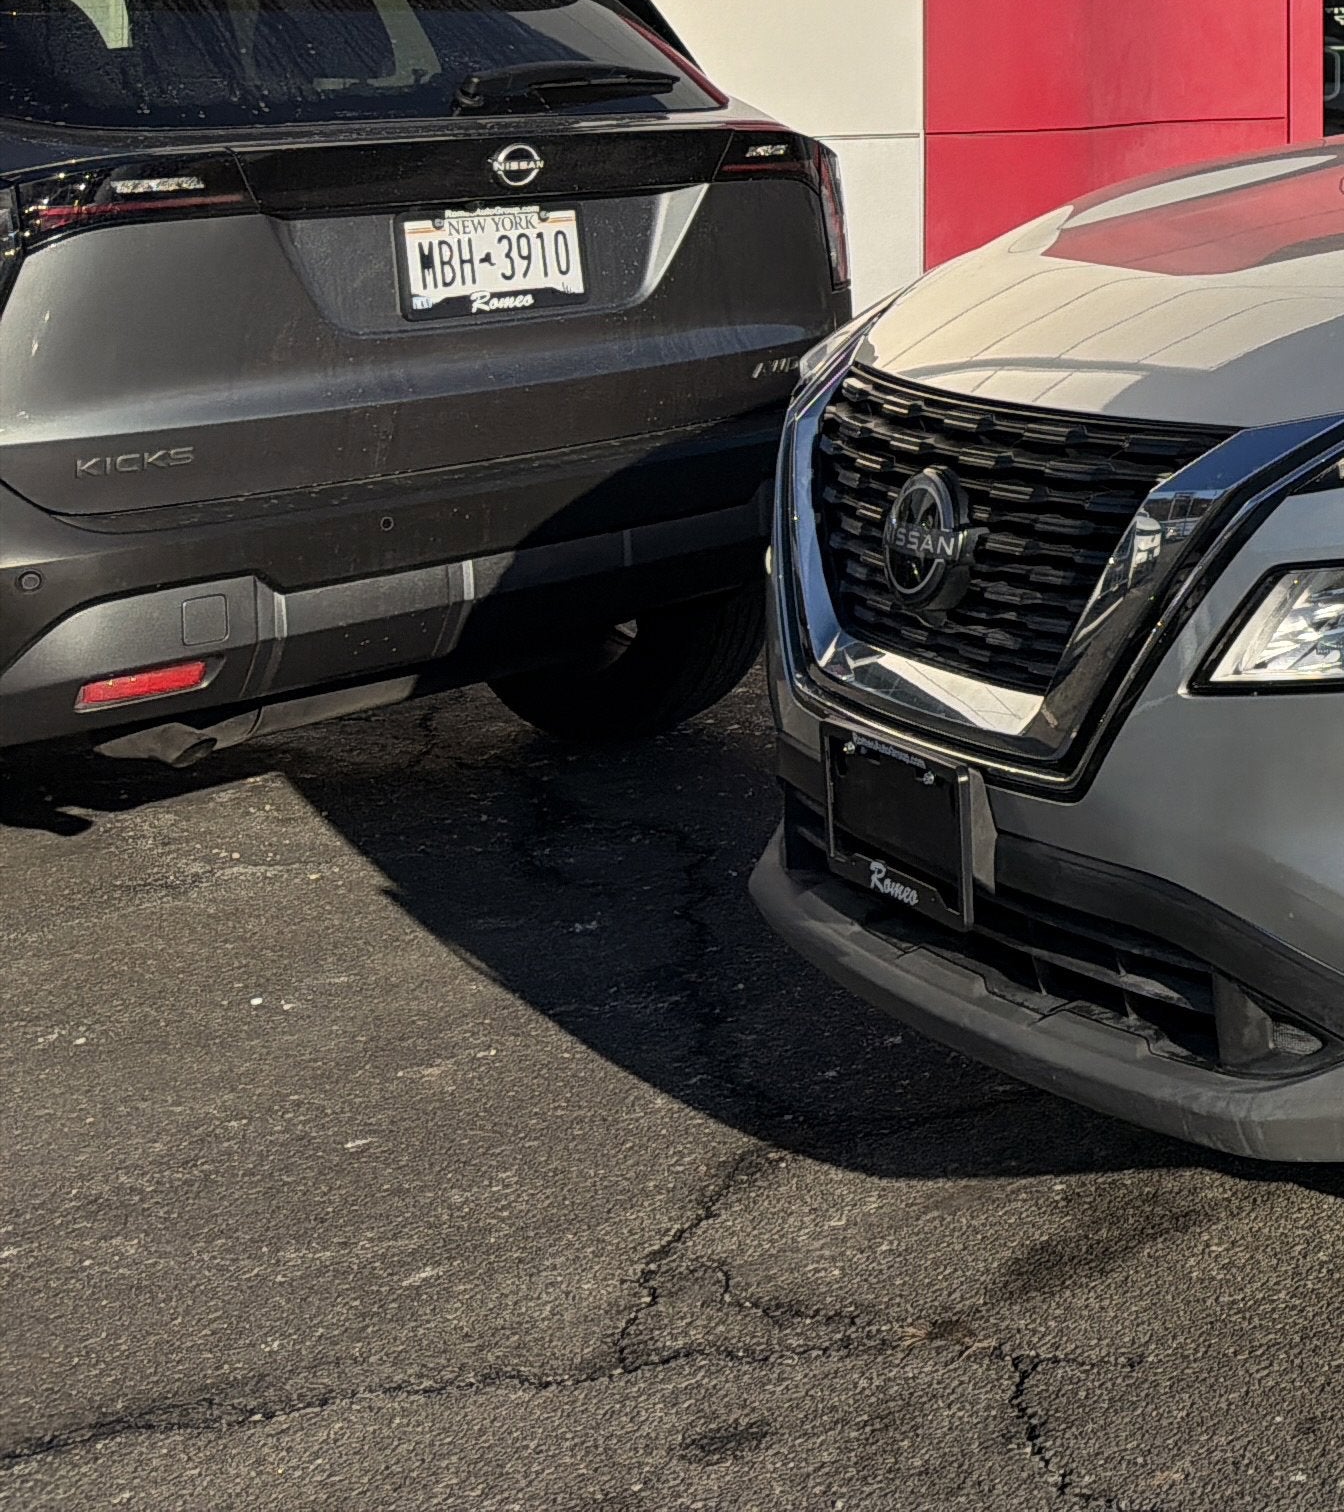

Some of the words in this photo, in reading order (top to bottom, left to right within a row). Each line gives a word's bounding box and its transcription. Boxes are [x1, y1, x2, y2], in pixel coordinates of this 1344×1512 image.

[493, 160, 544, 171] NISSAN
[447, 218, 487, 237] NEW
[490, 214, 538, 234] YORK
[417, 237, 477, 291] MBH
[497, 230, 571, 281] 3910
[469, 289, 535, 314] Romeo
[75, 446, 194, 478] KICKS
[869, 860, 919, 907] Romeo
